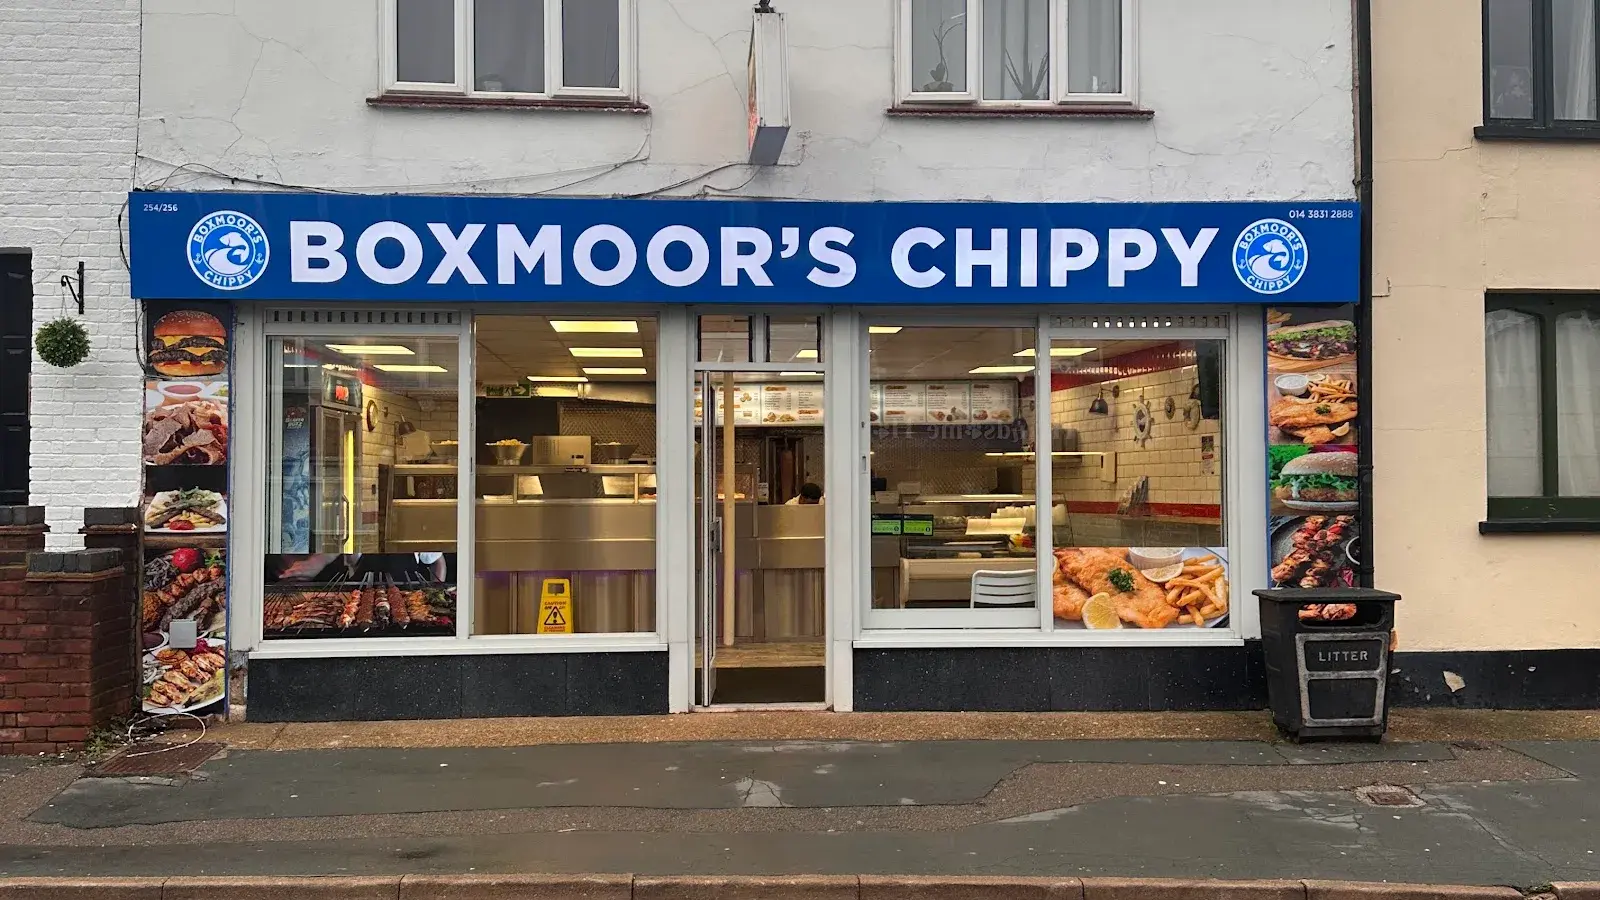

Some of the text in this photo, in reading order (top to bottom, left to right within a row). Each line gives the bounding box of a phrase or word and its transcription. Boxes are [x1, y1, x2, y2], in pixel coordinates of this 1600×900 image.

[143, 204, 178, 212] 254/256
[1289, 210, 1353, 218] 014 3831 2888
[193, 215, 263, 243] BOXMOOR'S
[1239, 223, 1302, 251] BOXMOOR'S
[290, 221, 857, 288] BOXMOOR'S
[891, 227, 1219, 288] CHIPPY
[204, 270, 253, 286] CHIPPY
[1247, 275, 1291, 291] CHIPPY
[1318, 651, 1368, 662] LITTER
